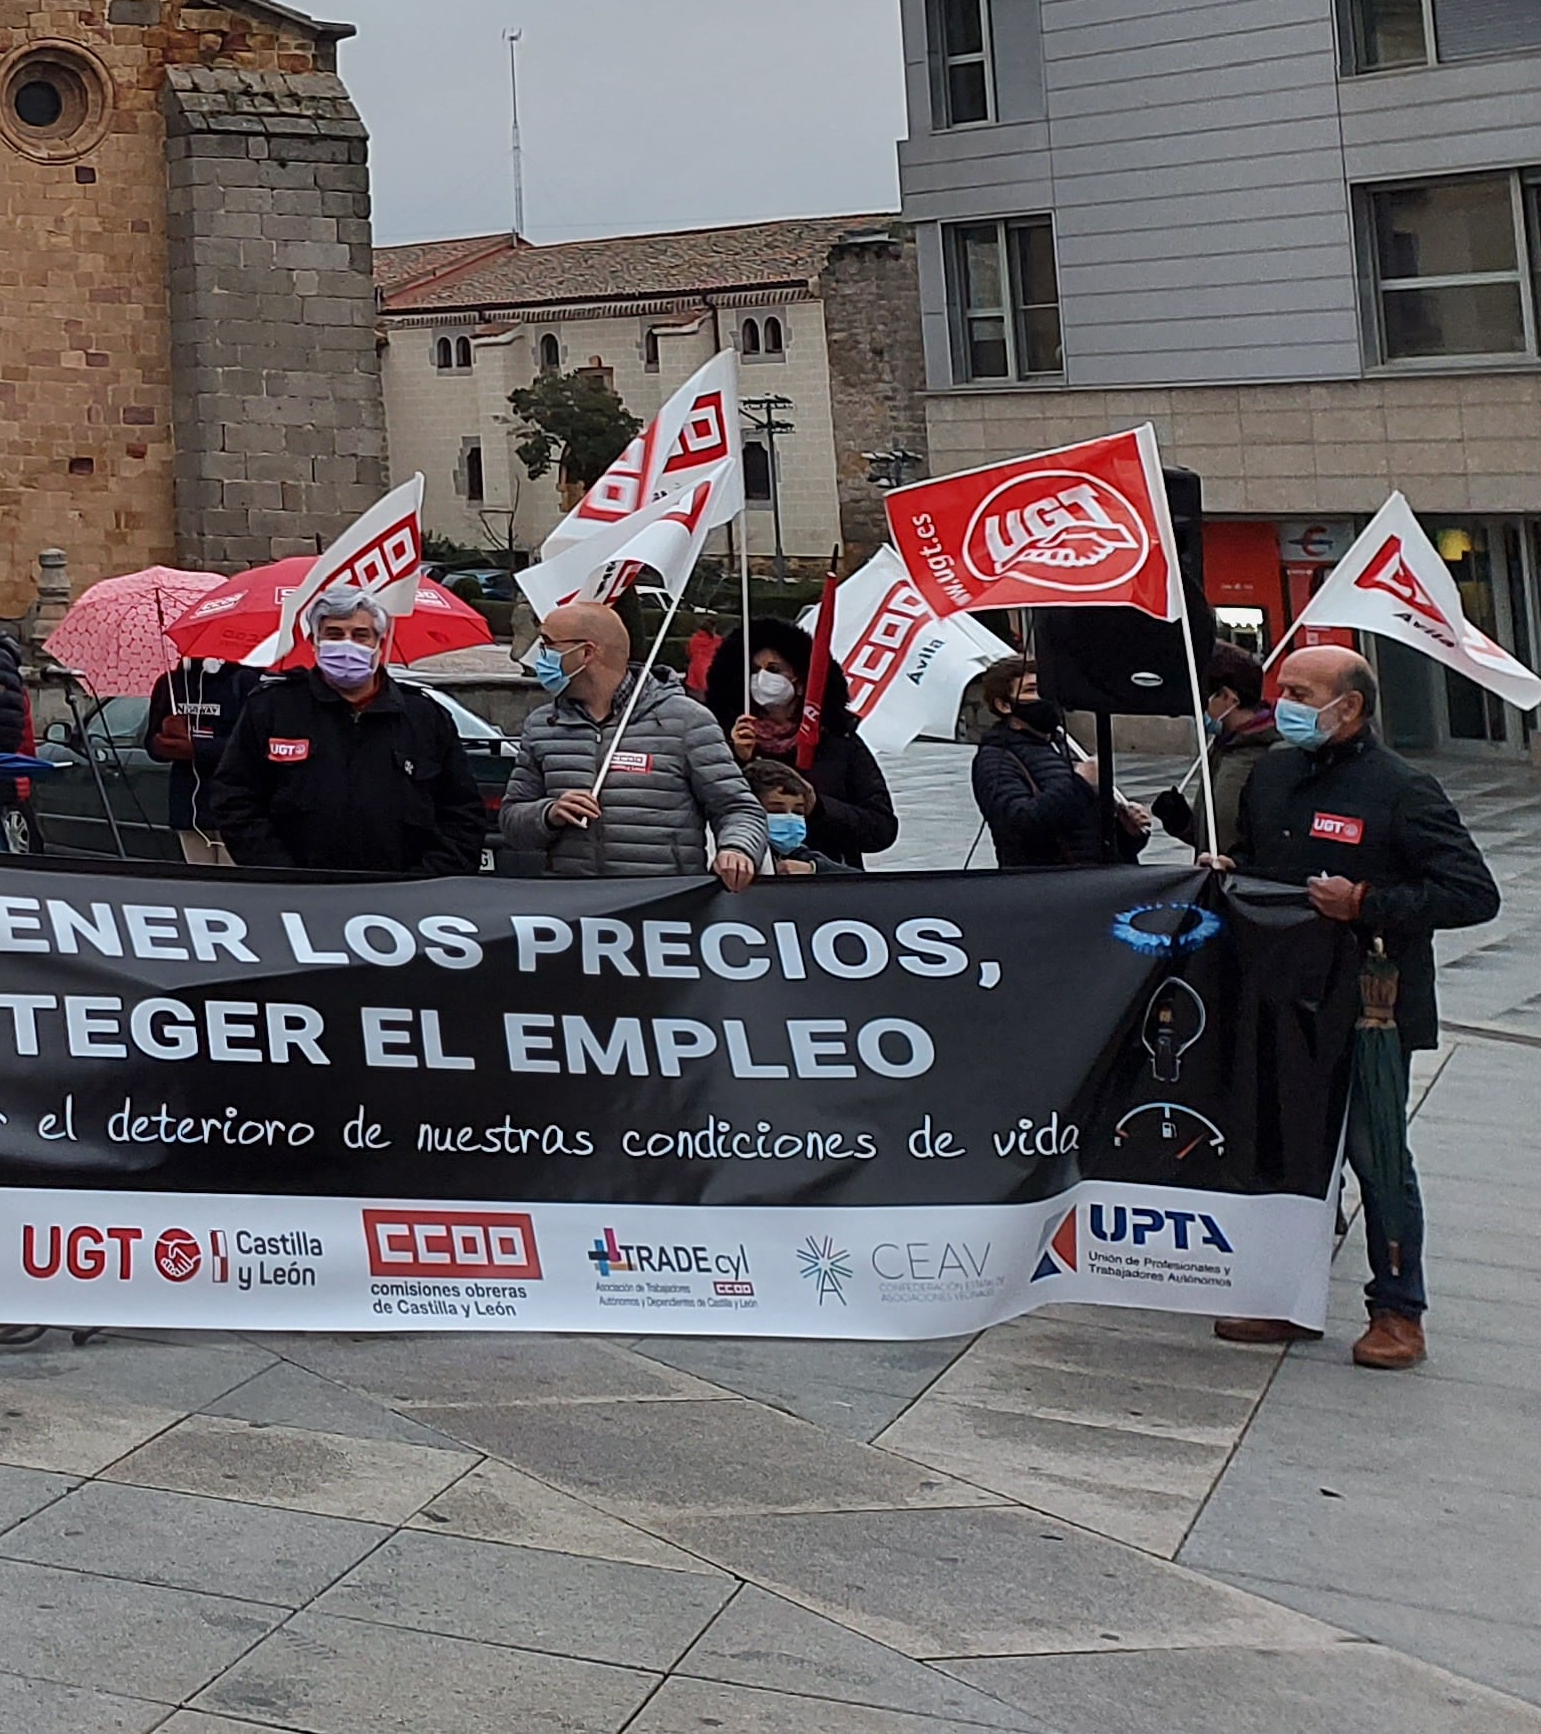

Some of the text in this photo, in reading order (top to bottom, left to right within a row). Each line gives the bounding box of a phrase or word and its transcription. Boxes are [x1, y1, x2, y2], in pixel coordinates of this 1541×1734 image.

[984, 483, 1117, 564] UGT
[269, 744, 296, 756] UGT
[1313, 817, 1345, 835] UGT
[281, 911, 483, 970] LOS
[510, 916, 1002, 989] PRECIOS,
[361, 1007, 476, 1072] EL
[503, 1012, 936, 1079] EMPLEO
[38, 1094, 79, 1142] el
[107, 1097, 316, 1148] deterioro
[343, 1104, 391, 1150] de
[418, 1113, 595, 1156] nuestras
[621, 1114, 878, 1161] condiciones
[907, 1114, 967, 1159] de
[993, 1111, 1080, 1157] vida
[235, 1229, 324, 1258] Castilla
[1089, 1203, 1235, 1254] UPTA
[21, 1224, 143, 1281] UGT
[374, 1221, 531, 1267] CCOO
[237, 1261, 317, 1291] y León
[871, 1241, 992, 1281] CEAV
[1088, 1250, 1232, 1277] Unión de Profesionales y
[1088, 1263, 1233, 1288] Trabajadores Autónomos
[370, 1280, 527, 1299] comisiones obreras
[716, 1283, 752, 1295] CCOO
[372, 1299, 517, 1318] de Castilla y León
